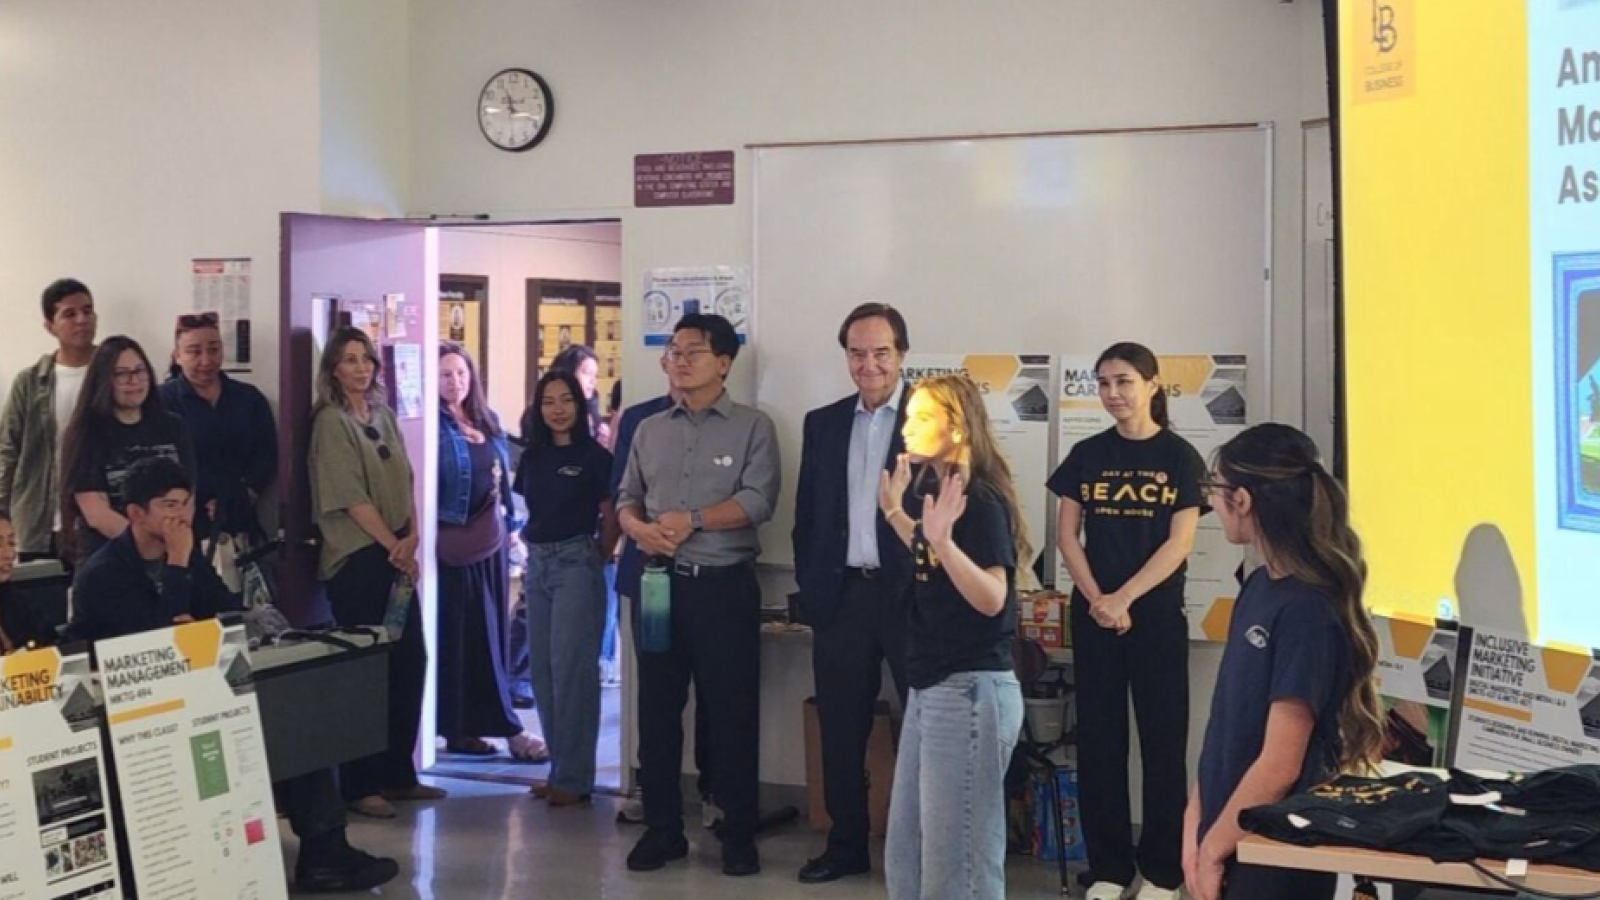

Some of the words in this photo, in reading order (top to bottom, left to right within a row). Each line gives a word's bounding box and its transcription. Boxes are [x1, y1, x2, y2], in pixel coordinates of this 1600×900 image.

[1081, 482, 1178, 506] BEACH
[1475, 632, 1529, 656] INCLUSIVE
[104, 646, 175, 674] MARKETING
[1473, 648, 1535, 673] MARKETING
[107, 658, 192, 688] MANAGEMENT
[1470, 662, 1524, 687] INITIATIVE
[26, 750, 59, 767] STUDENT
